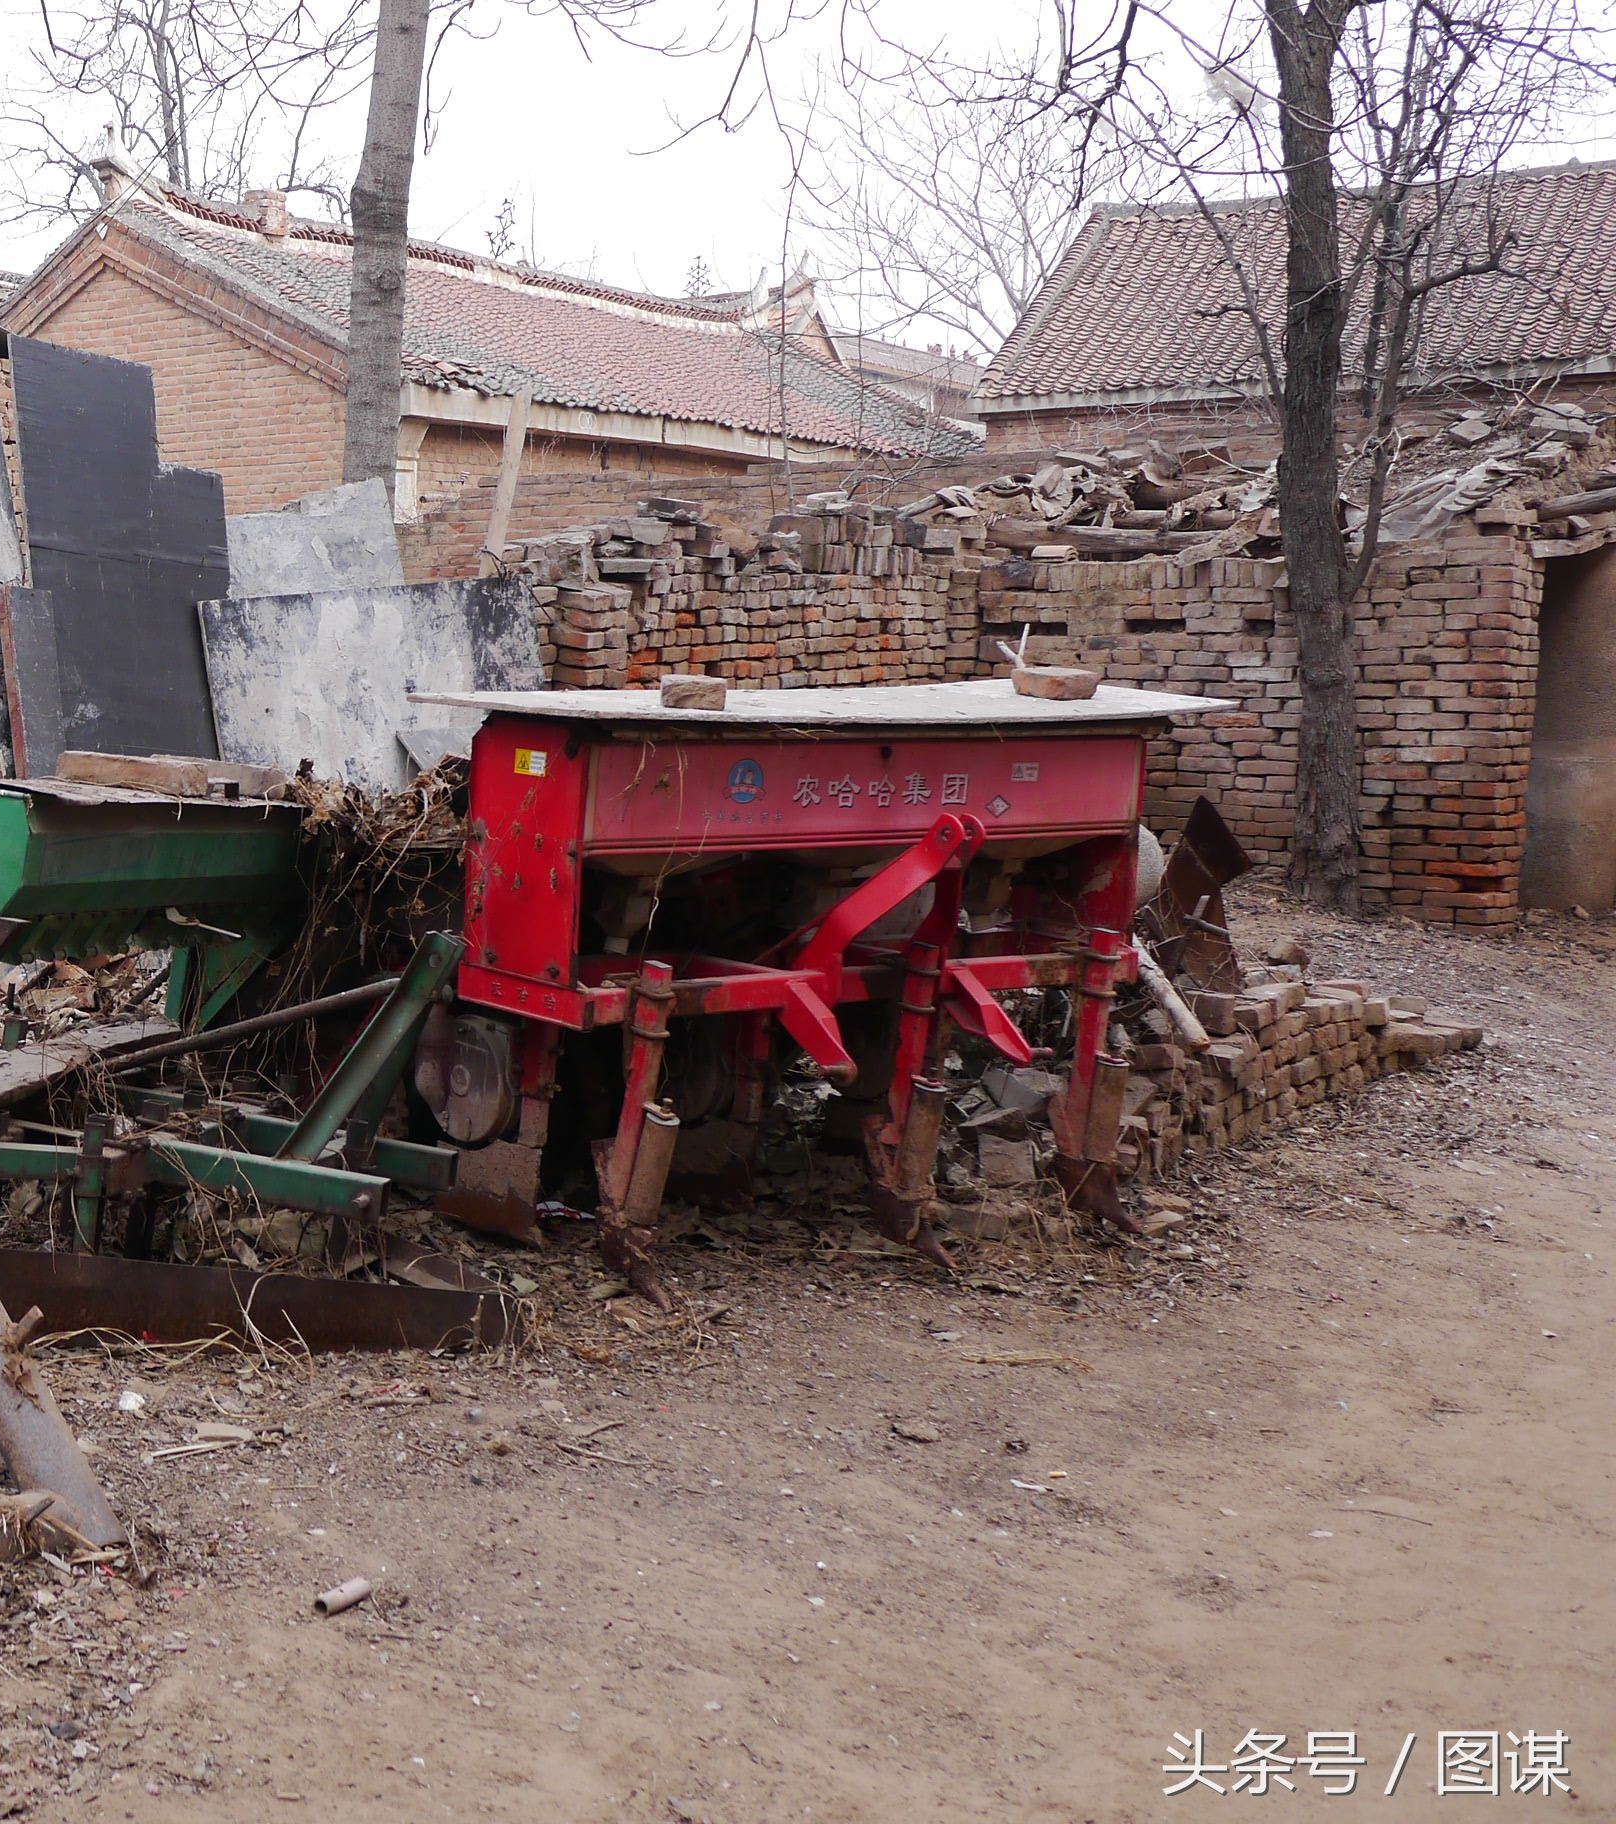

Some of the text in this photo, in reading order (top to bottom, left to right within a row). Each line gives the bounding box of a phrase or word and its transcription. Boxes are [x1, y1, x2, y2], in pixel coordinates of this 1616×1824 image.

[793, 771, 969, 808] 农哈哈集团
